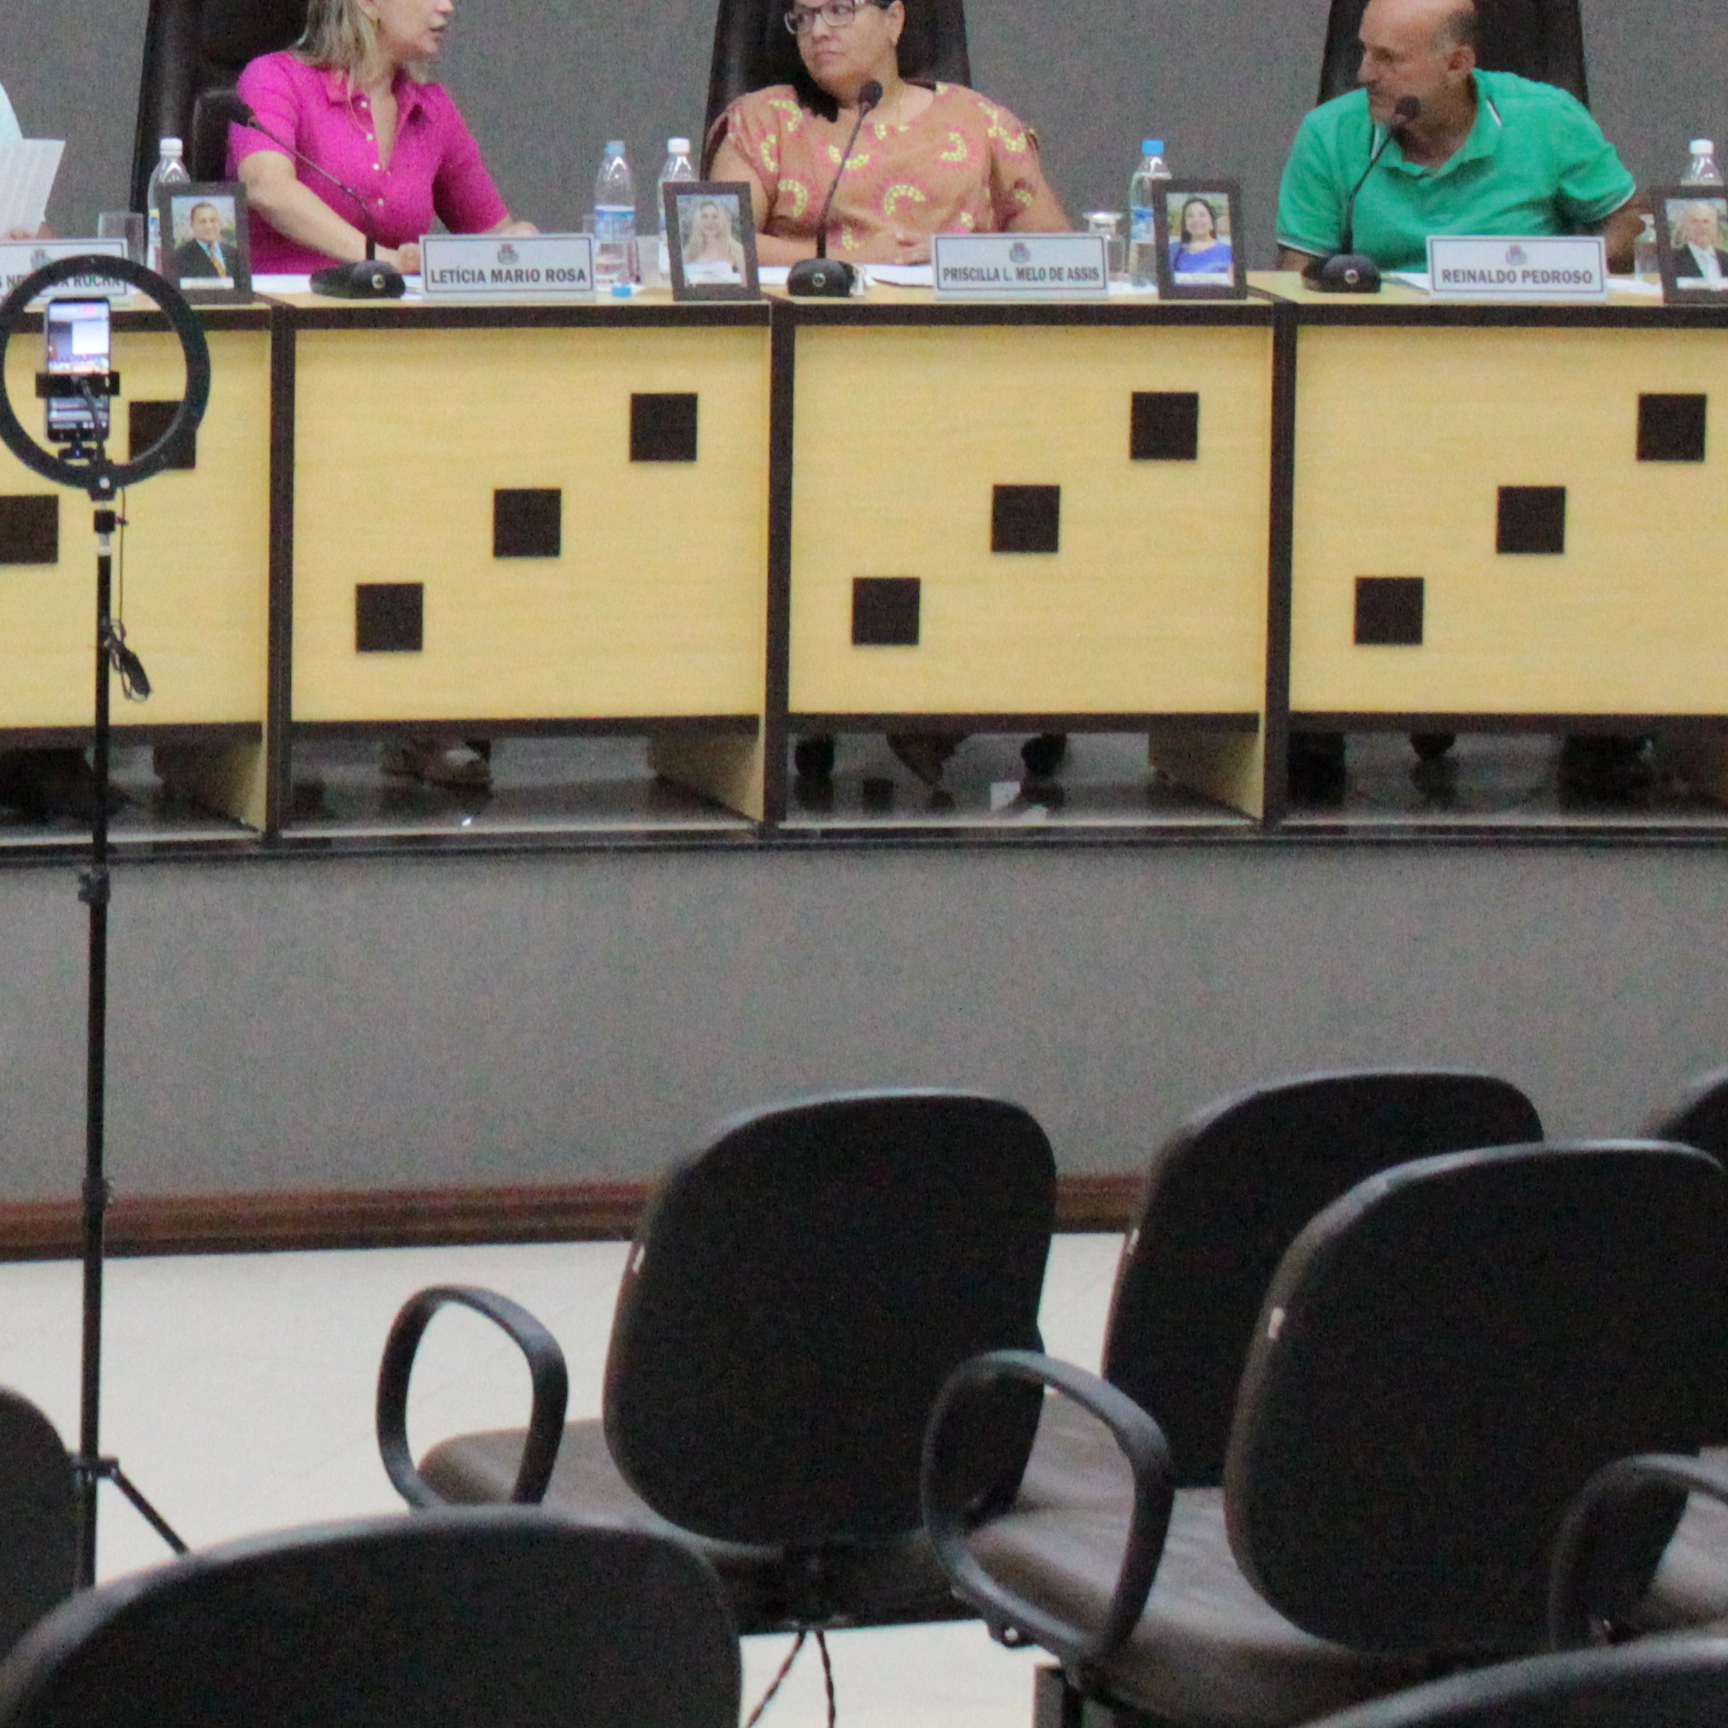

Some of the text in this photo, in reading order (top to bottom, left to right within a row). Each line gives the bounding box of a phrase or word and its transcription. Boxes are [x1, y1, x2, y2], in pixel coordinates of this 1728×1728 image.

[431, 265, 586, 284] LETÍCIA MARIO ROSA
[943, 266, 1099, 281] PRISCILLA L. MELO DE ASSIS
[1441, 269, 1593, 285] REINALDO PEDROSO
